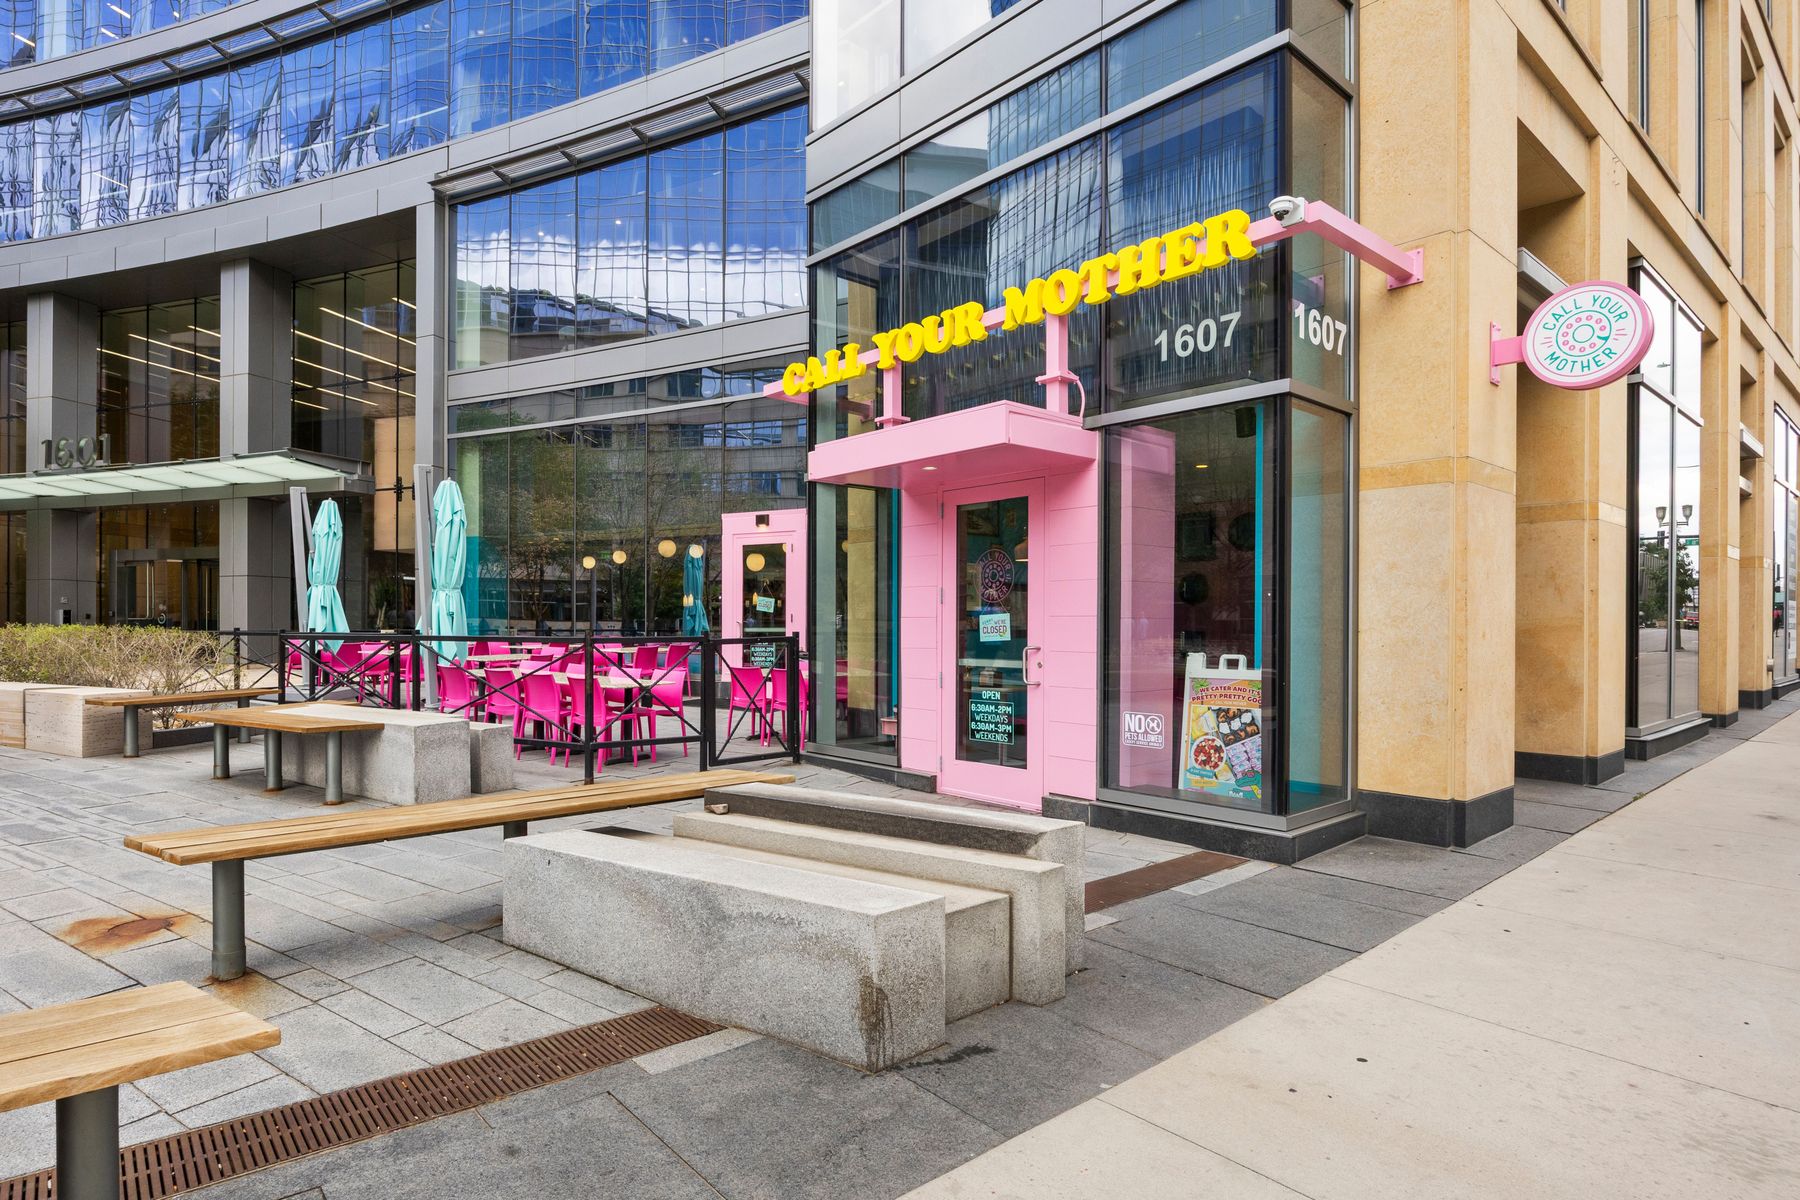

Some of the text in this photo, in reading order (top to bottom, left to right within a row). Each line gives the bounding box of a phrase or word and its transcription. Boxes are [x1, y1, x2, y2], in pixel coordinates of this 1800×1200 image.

[783, 209, 1257, 396] CALL YOUR MOTHER
[1542, 295, 1629, 331] CALL YOUR
[1154, 311, 1242, 362] 1607
[1294, 303, 1347, 356] 1607
[1544, 347, 1617, 373] MOTHER
[41, 433, 111, 469] 1601
[995, 551, 1012, 570] YOUR
[982, 625, 1008, 635] CLOSED
[982, 690, 1001, 700] OPEN
[1191, 694, 1218, 702] PRETTY
[971, 703, 1012, 714] 6:30AM-2PM
[974, 713, 1009, 723] WEEKDAYS
[1124, 713, 1146, 733] NO
[974, 731, 1009, 742] WEEKENDS
[1124, 731, 1163, 743] PETS ALLOWED
